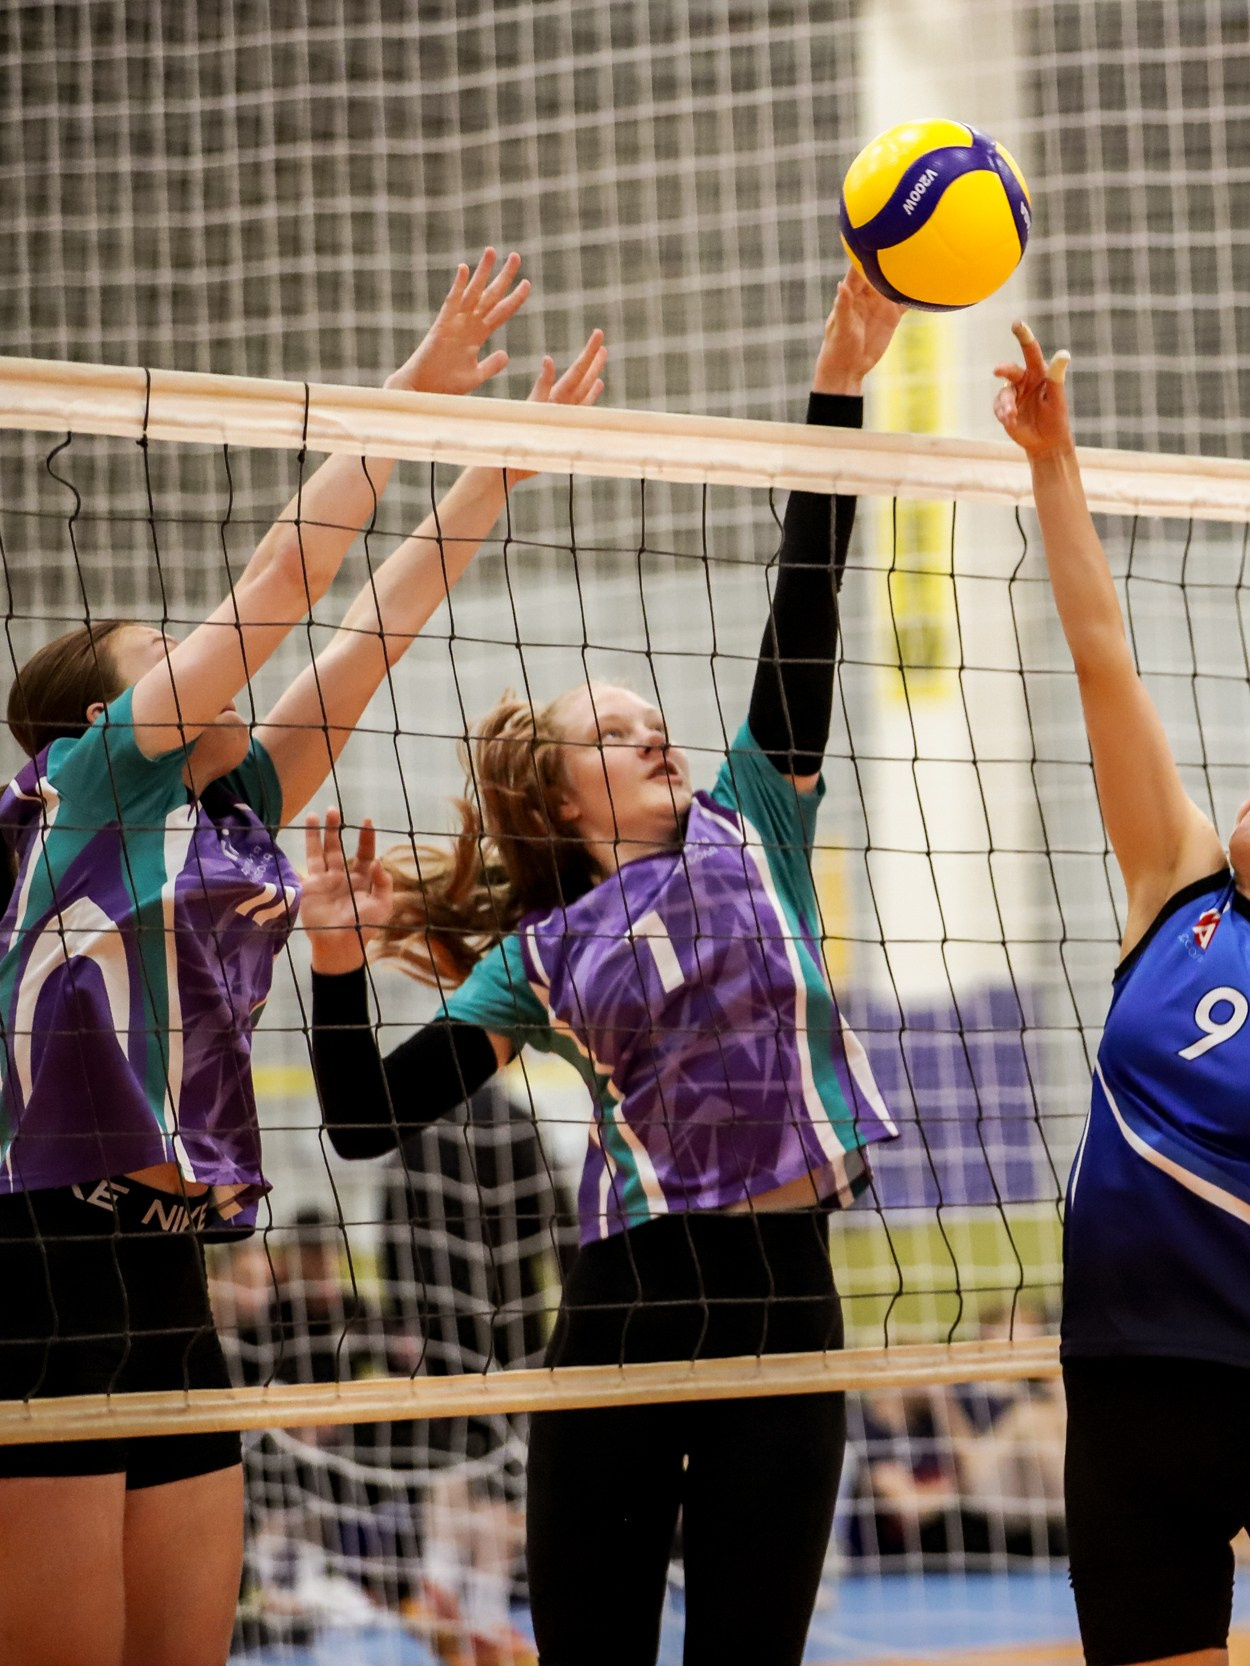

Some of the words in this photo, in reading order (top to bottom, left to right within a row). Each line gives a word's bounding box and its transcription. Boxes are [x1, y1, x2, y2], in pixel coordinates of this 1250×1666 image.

[902, 168, 938, 216] V200W
[1178, 986, 1249, 1061] 9
[141, 1198, 208, 1233] NIKE
